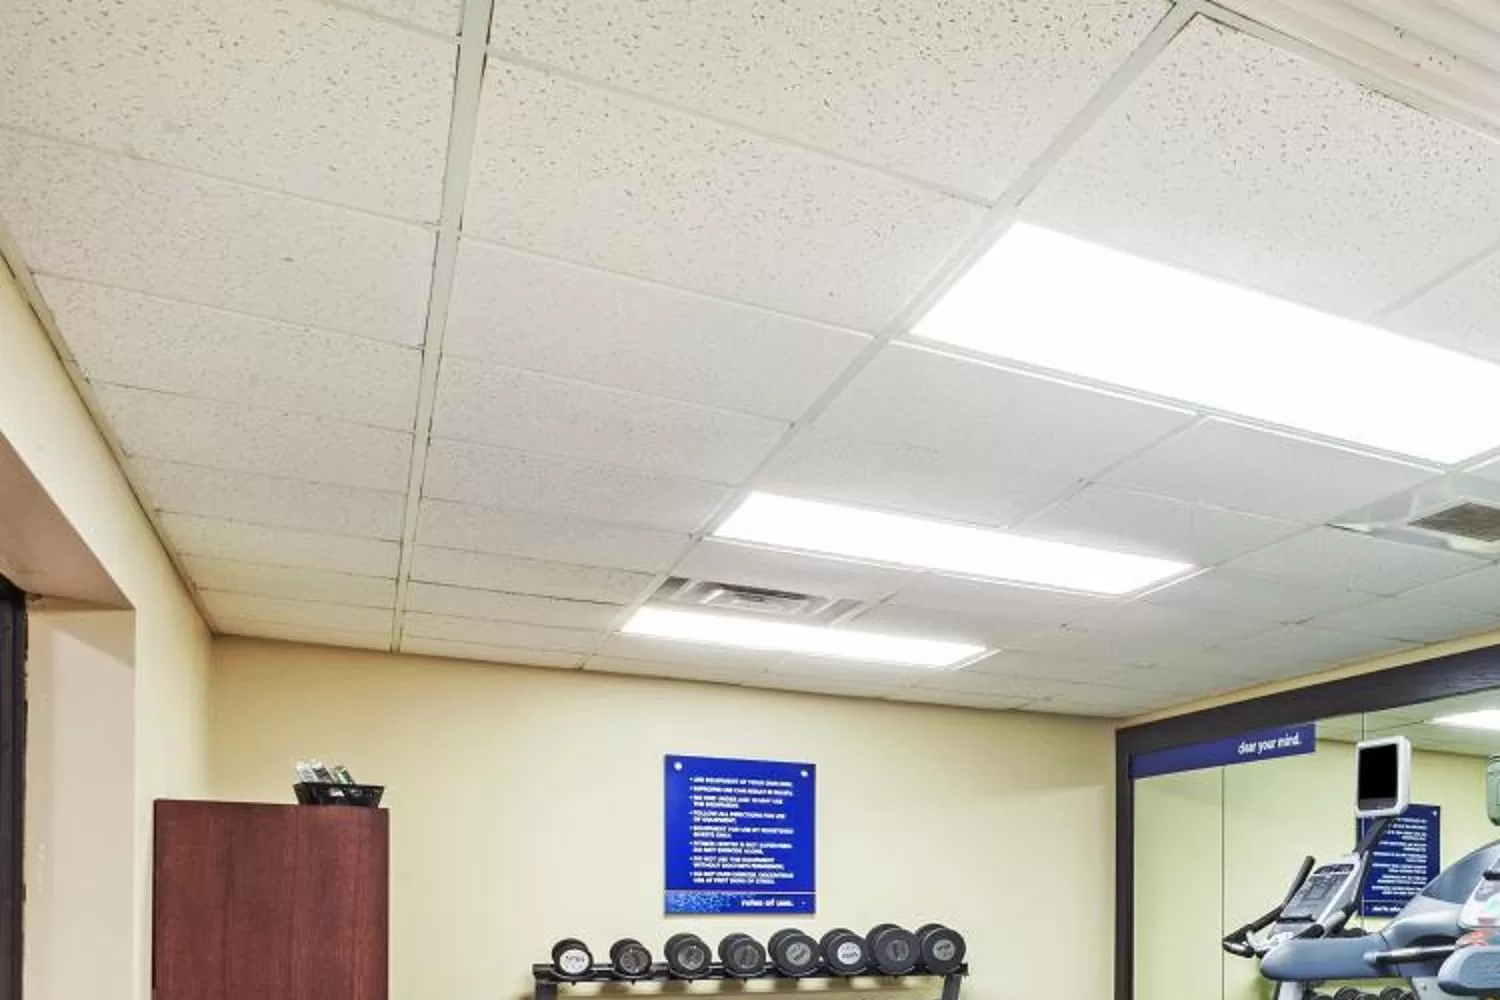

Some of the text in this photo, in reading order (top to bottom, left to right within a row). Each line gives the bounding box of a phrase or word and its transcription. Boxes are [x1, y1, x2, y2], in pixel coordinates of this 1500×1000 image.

[1237, 732, 1303, 756] clear your mind.
